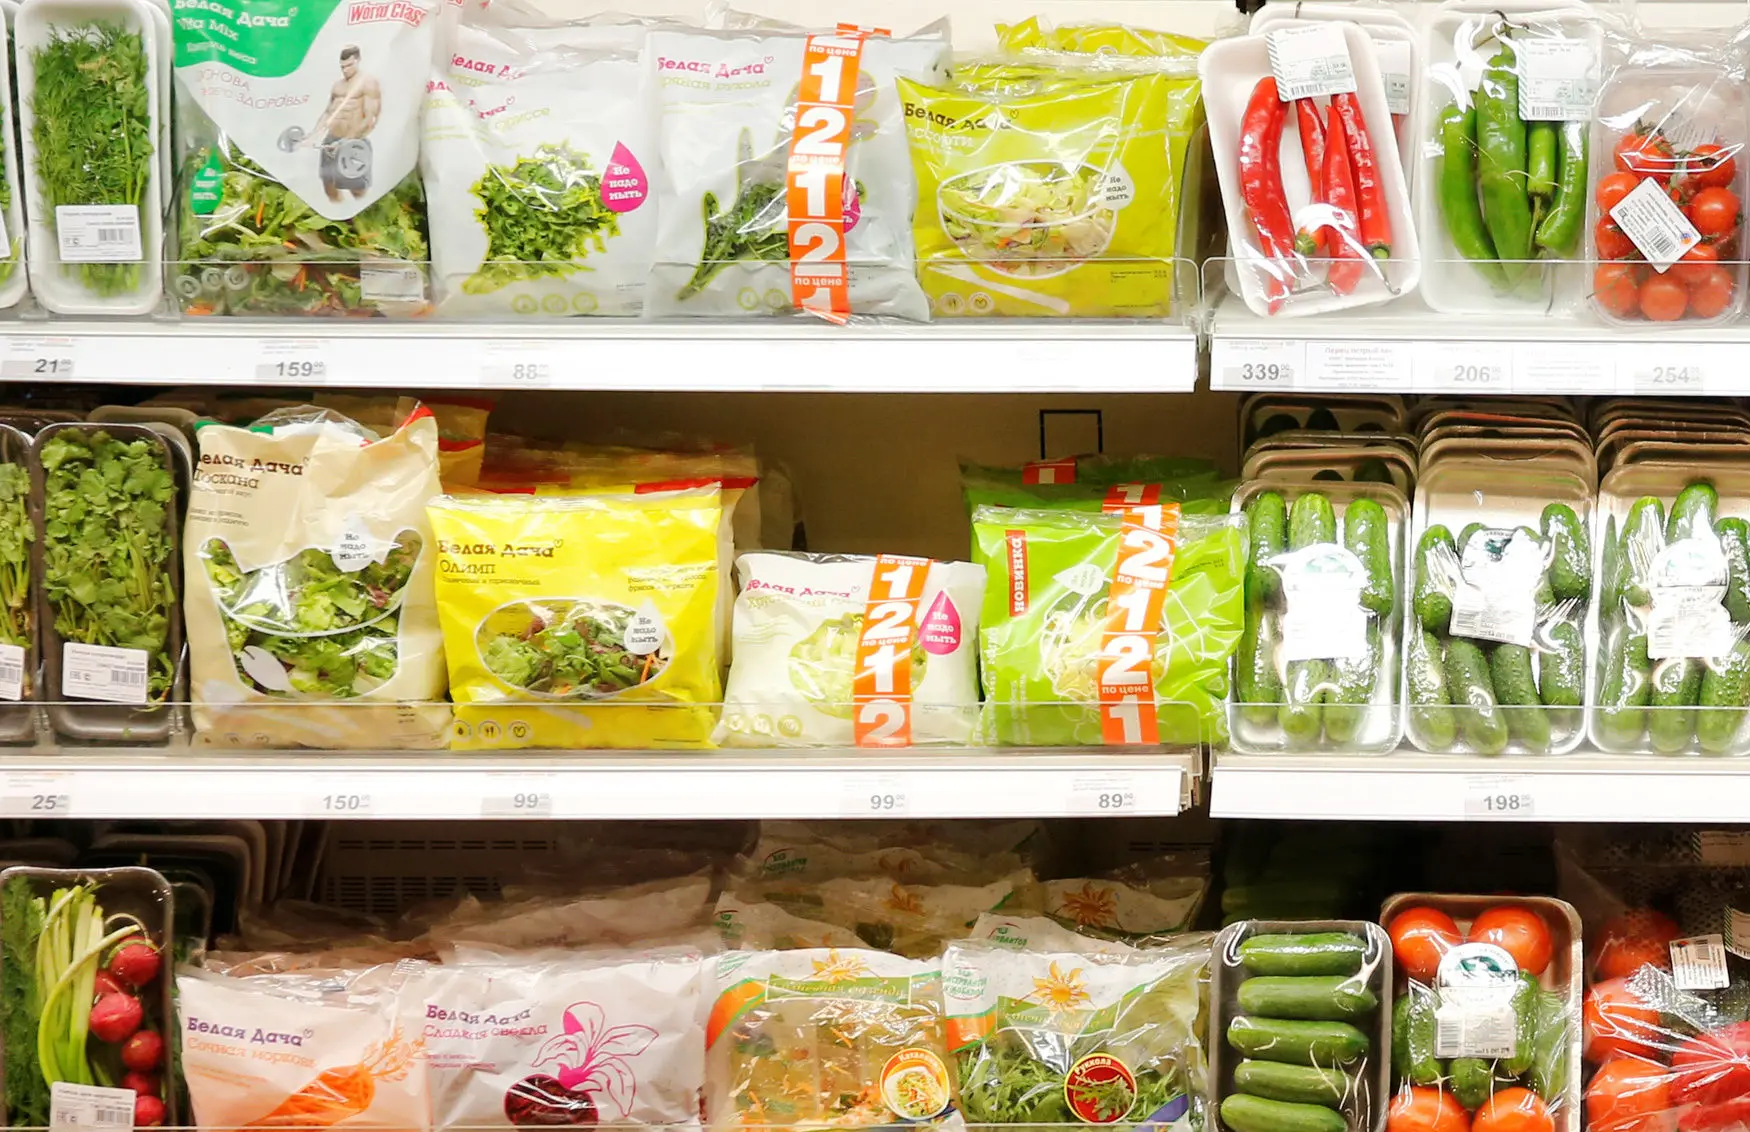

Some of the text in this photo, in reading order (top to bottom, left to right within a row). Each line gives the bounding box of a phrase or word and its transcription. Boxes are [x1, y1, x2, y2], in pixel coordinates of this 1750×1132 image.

[237, 11, 289, 28] Дача
[808, 44, 858, 58] по цене
[716, 63, 765, 80] Дача
[809, 55, 845, 104] 1
[905, 102, 956, 130] Белая
[793, 106, 846, 156] 2
[794, 168, 828, 217] 1
[793, 222, 843, 278] 2
[794, 276, 843, 288] по цене
[35, 359, 58, 373] 21
[276, 361, 313, 376] 159
[513, 364, 538, 380] 88
[1242, 363, 1279, 380] 339
[1453, 365, 1490, 383] 206
[1653, 367, 1690, 384] 254
[250, 458, 304, 476] Дача
[193, 467, 260, 489] Тоскана
[438, 540, 555, 558] Белая Дача
[1119, 530, 1170, 581] 2
[440, 559, 496, 574] Олимп
[880, 565, 913, 599] 1
[1117, 574, 1132, 584] по
[1117, 588, 1153, 631] 1
[863, 602, 914, 640] 2
[864, 645, 896, 692] 1
[1101, 634, 1151, 686] 2
[1102, 685, 1149, 695] по цене
[859, 698, 907, 745] 2
[1109, 694, 1142, 744] 1
[32, 794, 57, 810] 25
[323, 794, 360, 810] 150
[514, 793, 539, 808] 99
[870, 795, 895, 810] 99
[1098, 793, 1123, 808] 89
[1483, 795, 1520, 811] 198
[426, 1004, 531, 1026] Белая Дача
[187, 1016, 303, 1046] Белая Дача
[424, 1025, 488, 1040] Сладкая
[1074, 1057, 1113, 1076] Руккола
